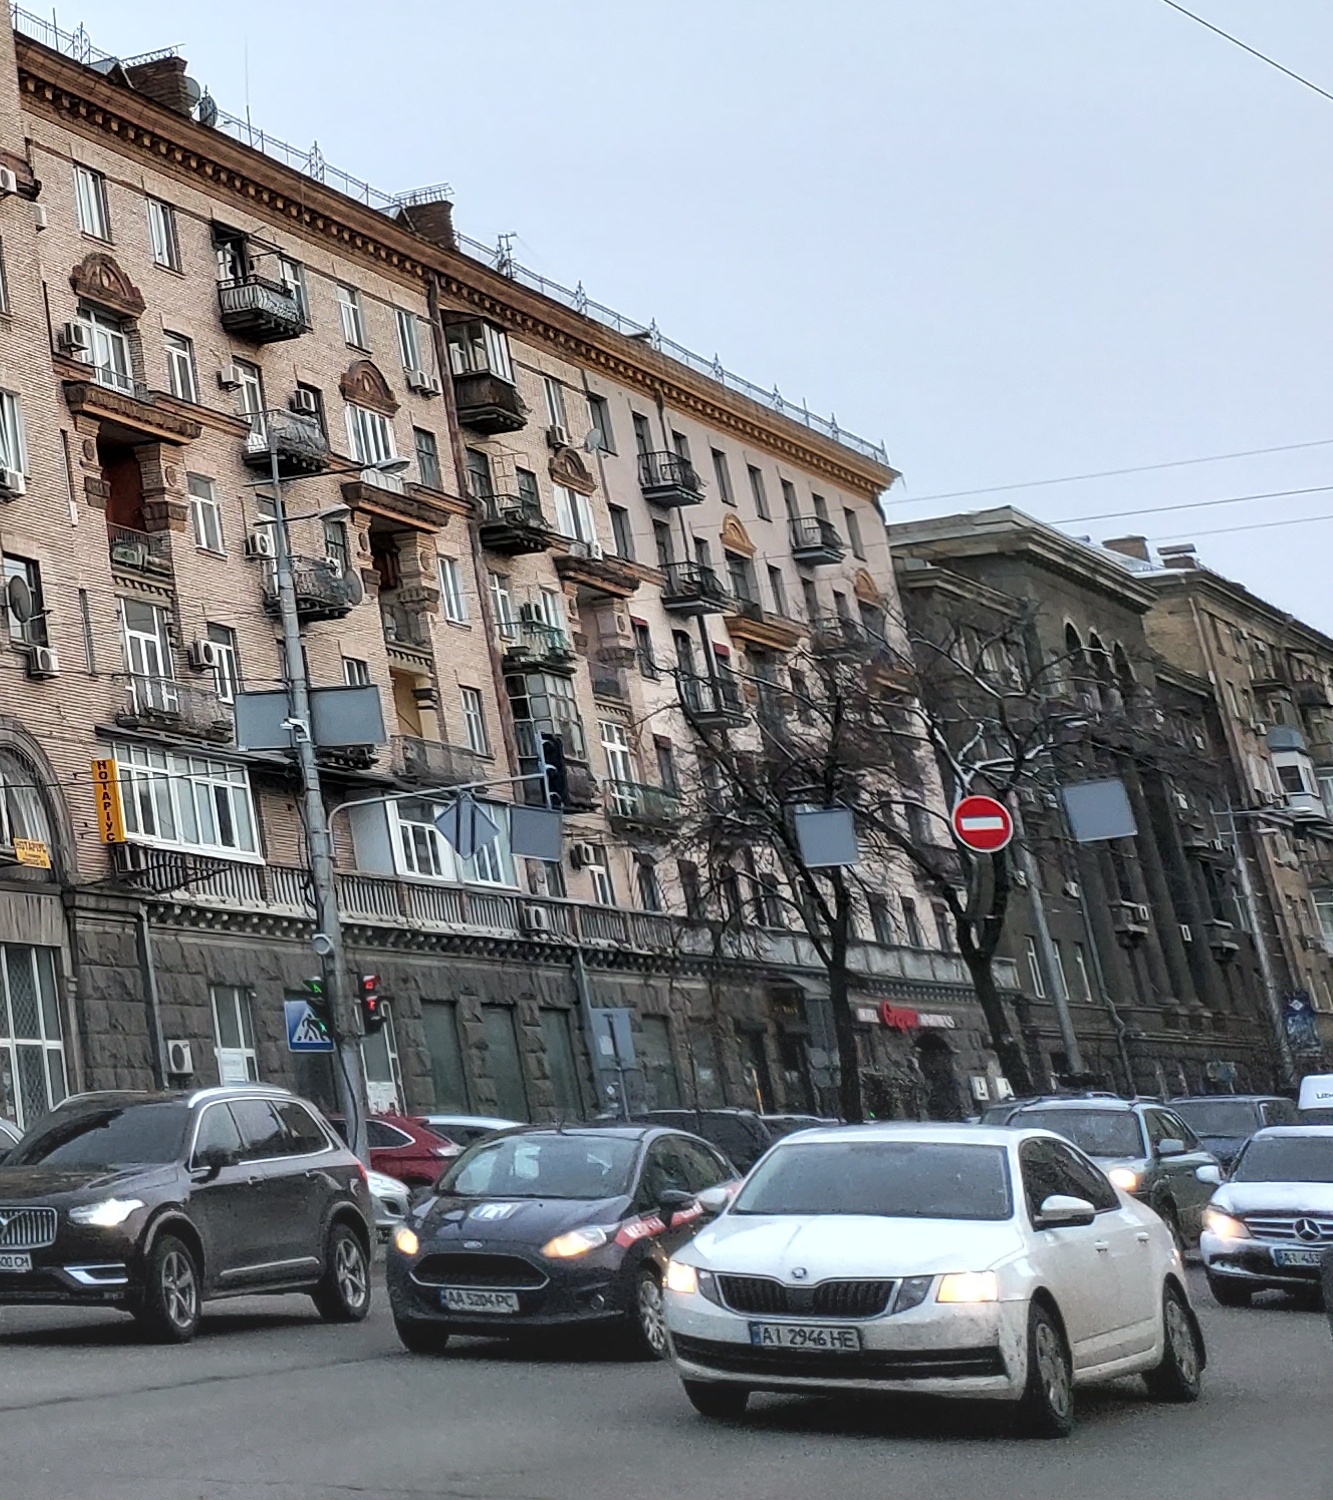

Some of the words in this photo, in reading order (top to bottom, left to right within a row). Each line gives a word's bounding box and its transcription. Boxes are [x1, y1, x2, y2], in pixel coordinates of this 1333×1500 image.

[97, 760, 115, 841] НОТАРІУС
[763, 1327, 782, 1344] AI
[788, 1329, 826, 1346] 2946
[830, 1331, 855, 1348] HE
